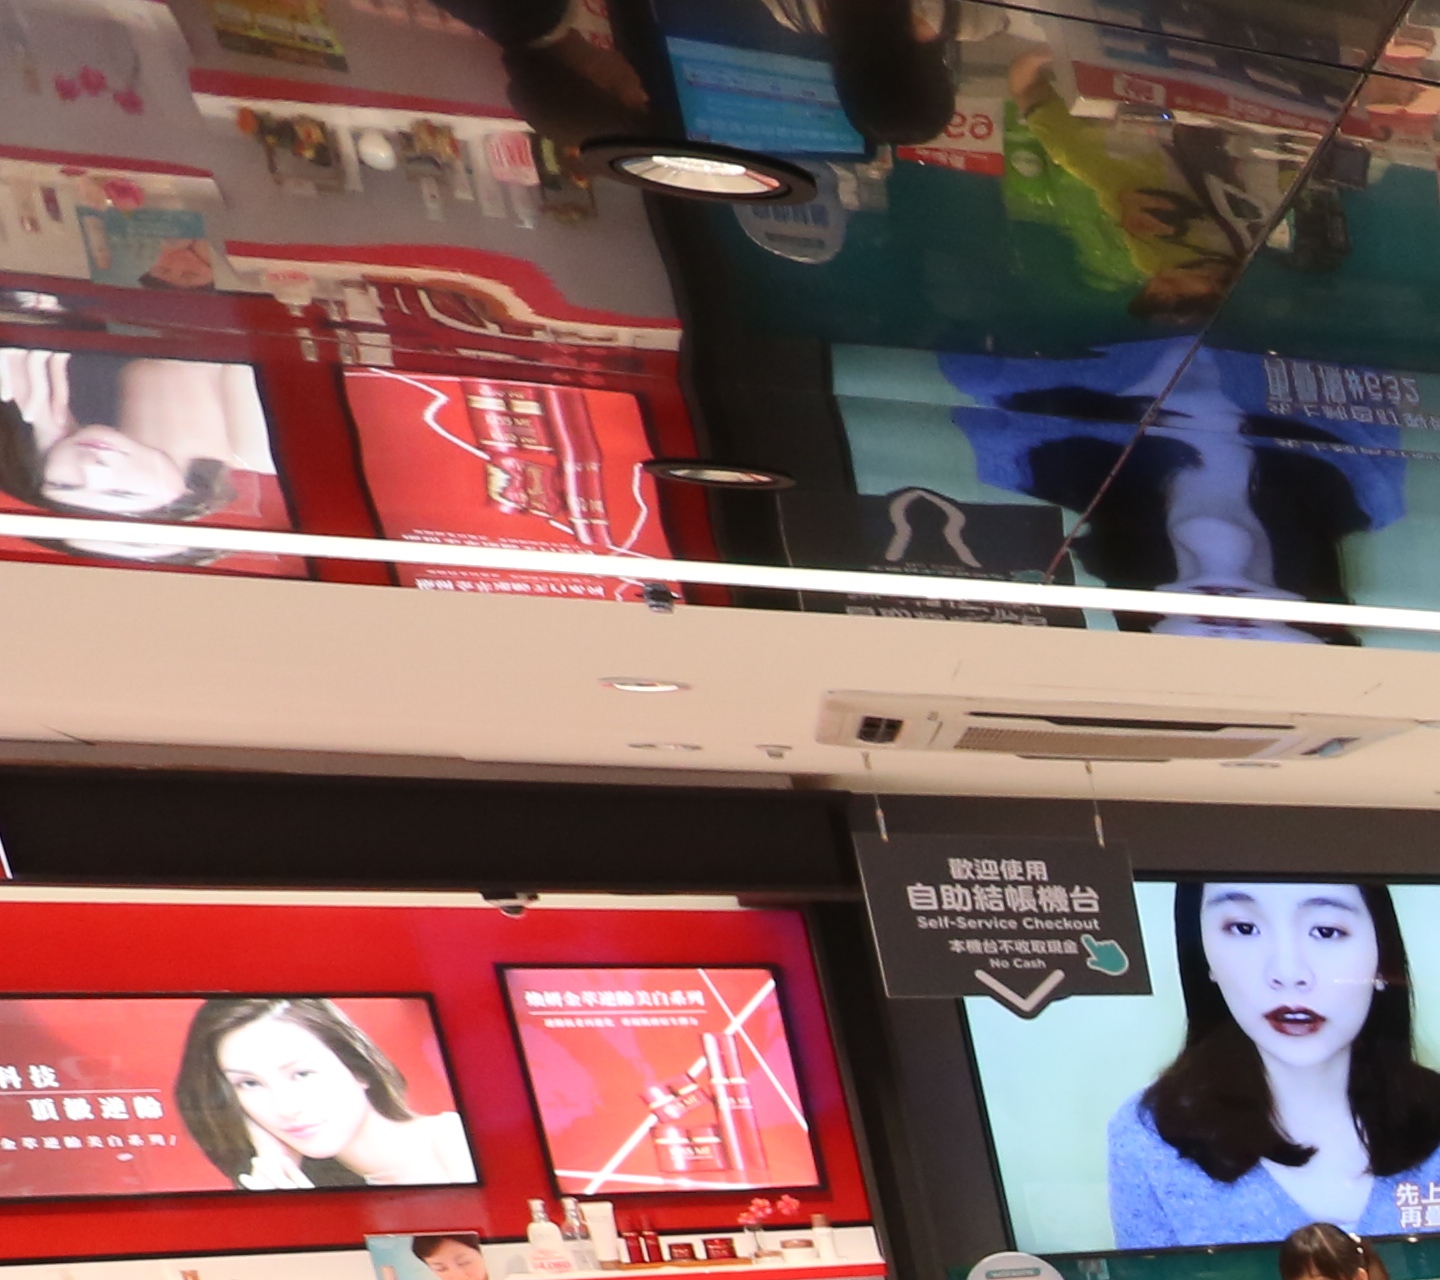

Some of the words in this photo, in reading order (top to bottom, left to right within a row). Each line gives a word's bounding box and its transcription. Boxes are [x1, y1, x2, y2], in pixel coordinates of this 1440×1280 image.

[948, 858, 1049, 882] 歡迎使用
[906, 883, 1099, 913] 自助結帳機台
[917, 915, 1017, 930] Self-Service
[1022, 917, 1100, 931] Checkout
[949, 939, 1079, 955] 本機台不收取現金
[989, 957, 1010, 969] No
[1013, 958, 1047, 969] Cash
